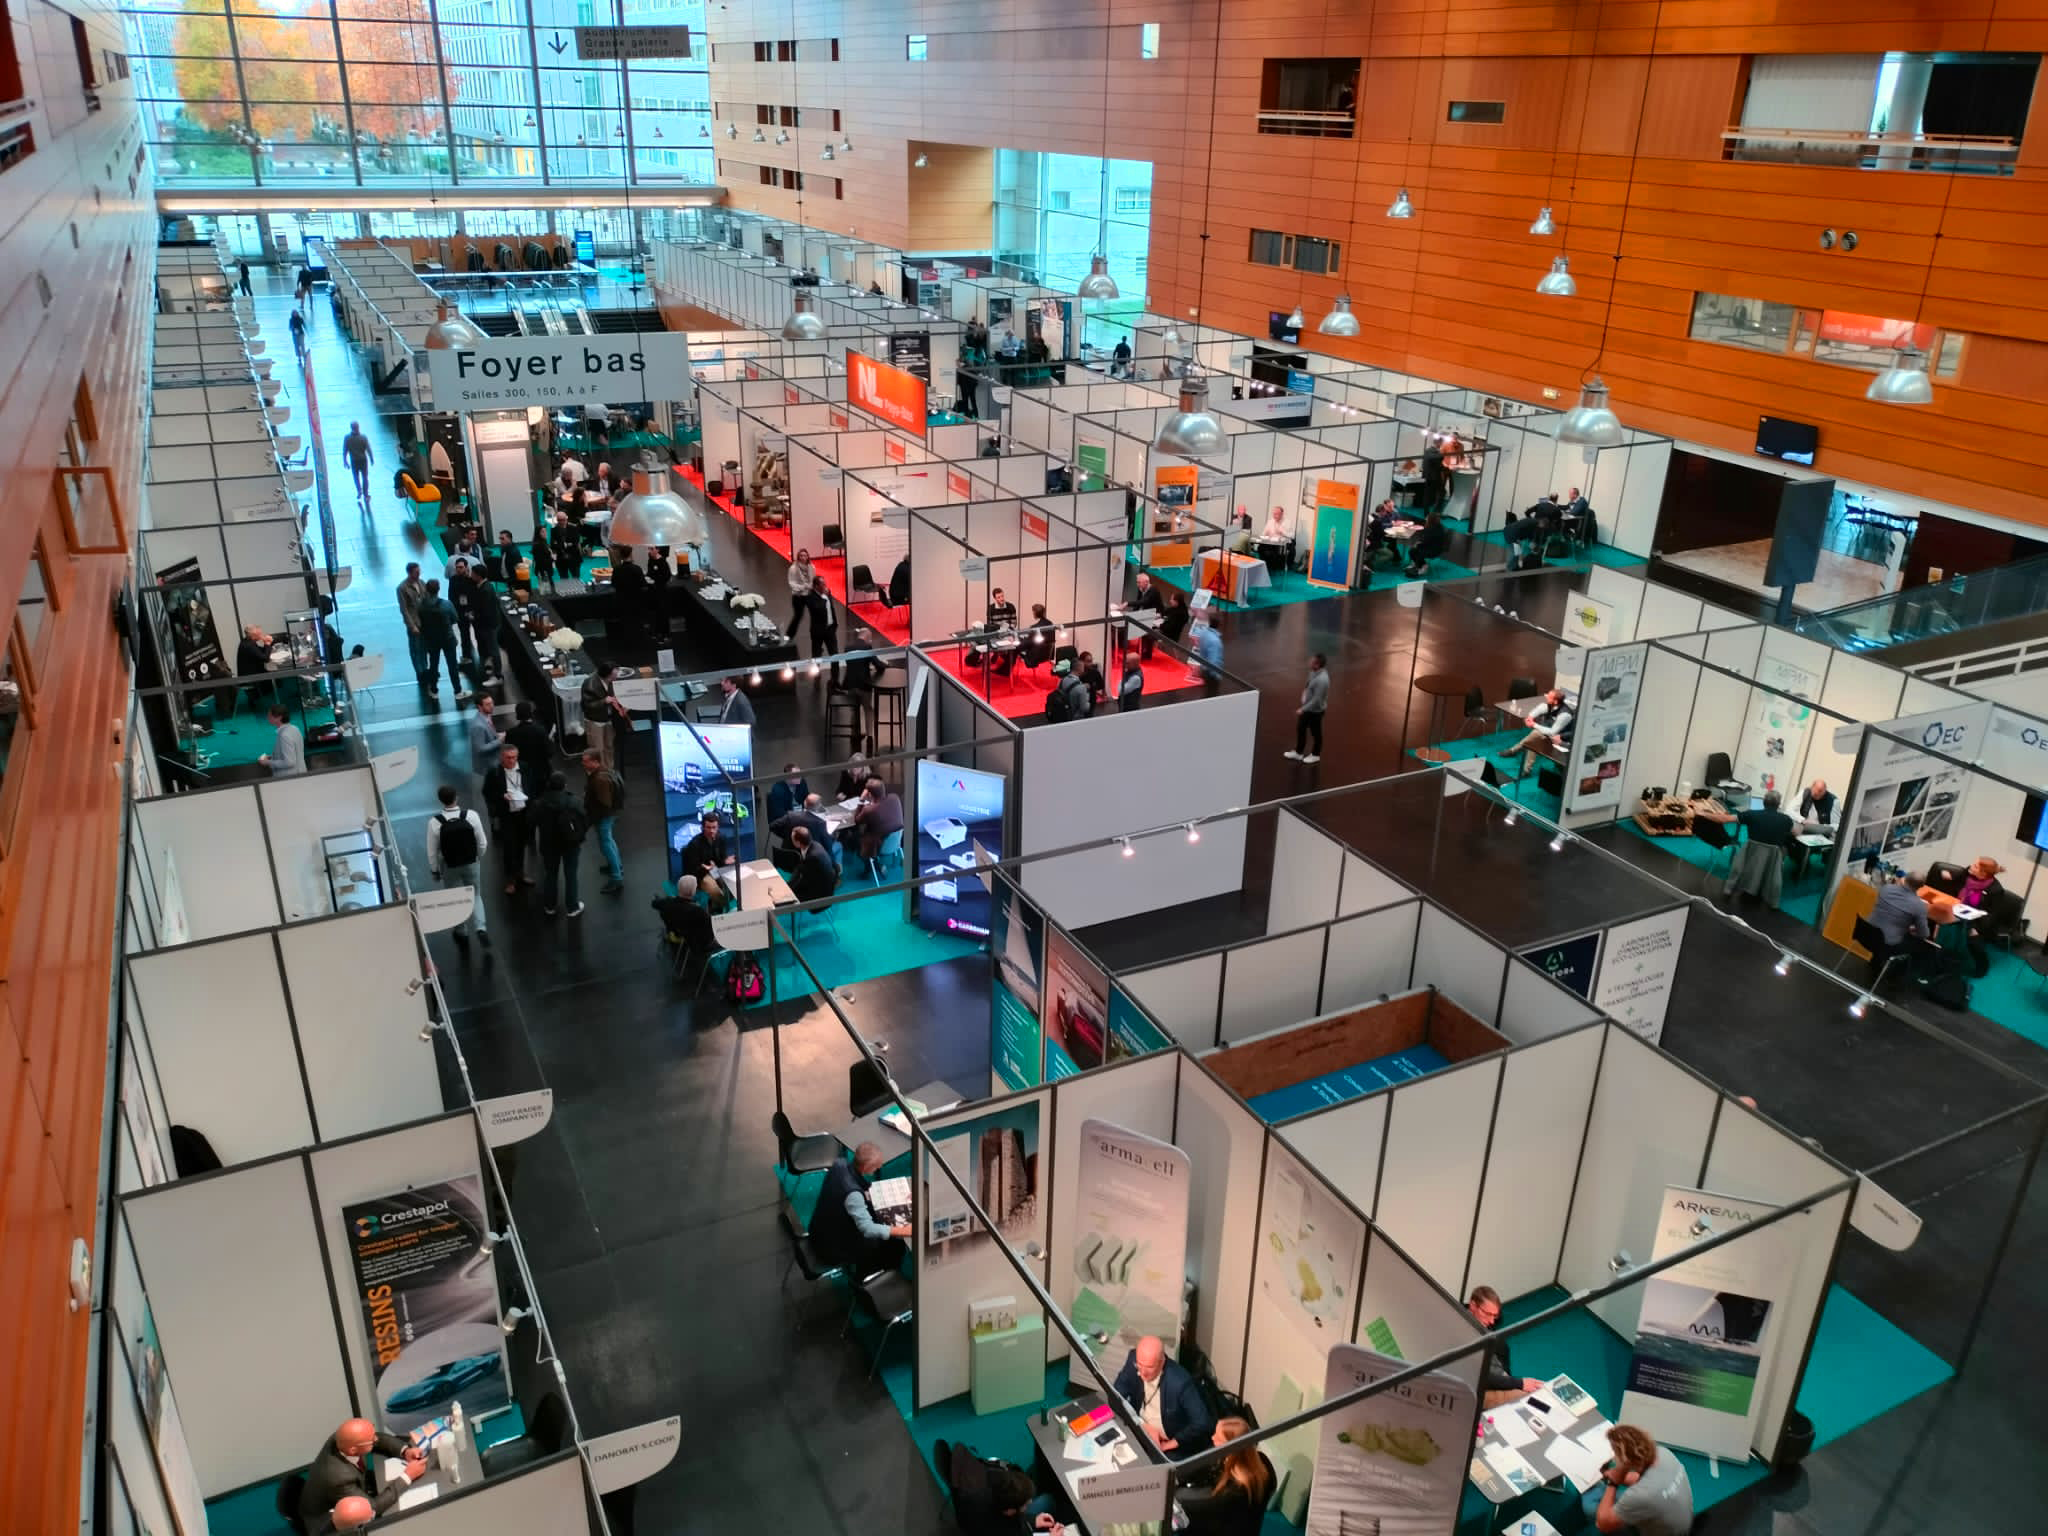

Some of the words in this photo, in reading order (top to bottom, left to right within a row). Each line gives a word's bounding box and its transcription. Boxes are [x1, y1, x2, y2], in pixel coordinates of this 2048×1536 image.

[585, 38, 625, 48] Grande
[631, 38, 670, 49] galerie
[586, 48, 619, 58] Grand
[624, 47, 684, 57] auditorium
[457, 351, 563, 383] Foyer
[583, 346, 647, 374] bas
[461, 390, 500, 401] Salles
[504, 387, 531, 399] 300,
[536, 386, 562, 398] 150,
[566, 385, 575, 395] A
[590, 384, 600, 395] F
[381, 1200, 449, 1224] Crestapol
[1673, 1199, 1754, 1223] ARKEMA
[368, 1284, 402, 1366] RESINS
[665, 1417, 679, 1428] 60
[594, 1445, 639, 1463] DANOBAT
